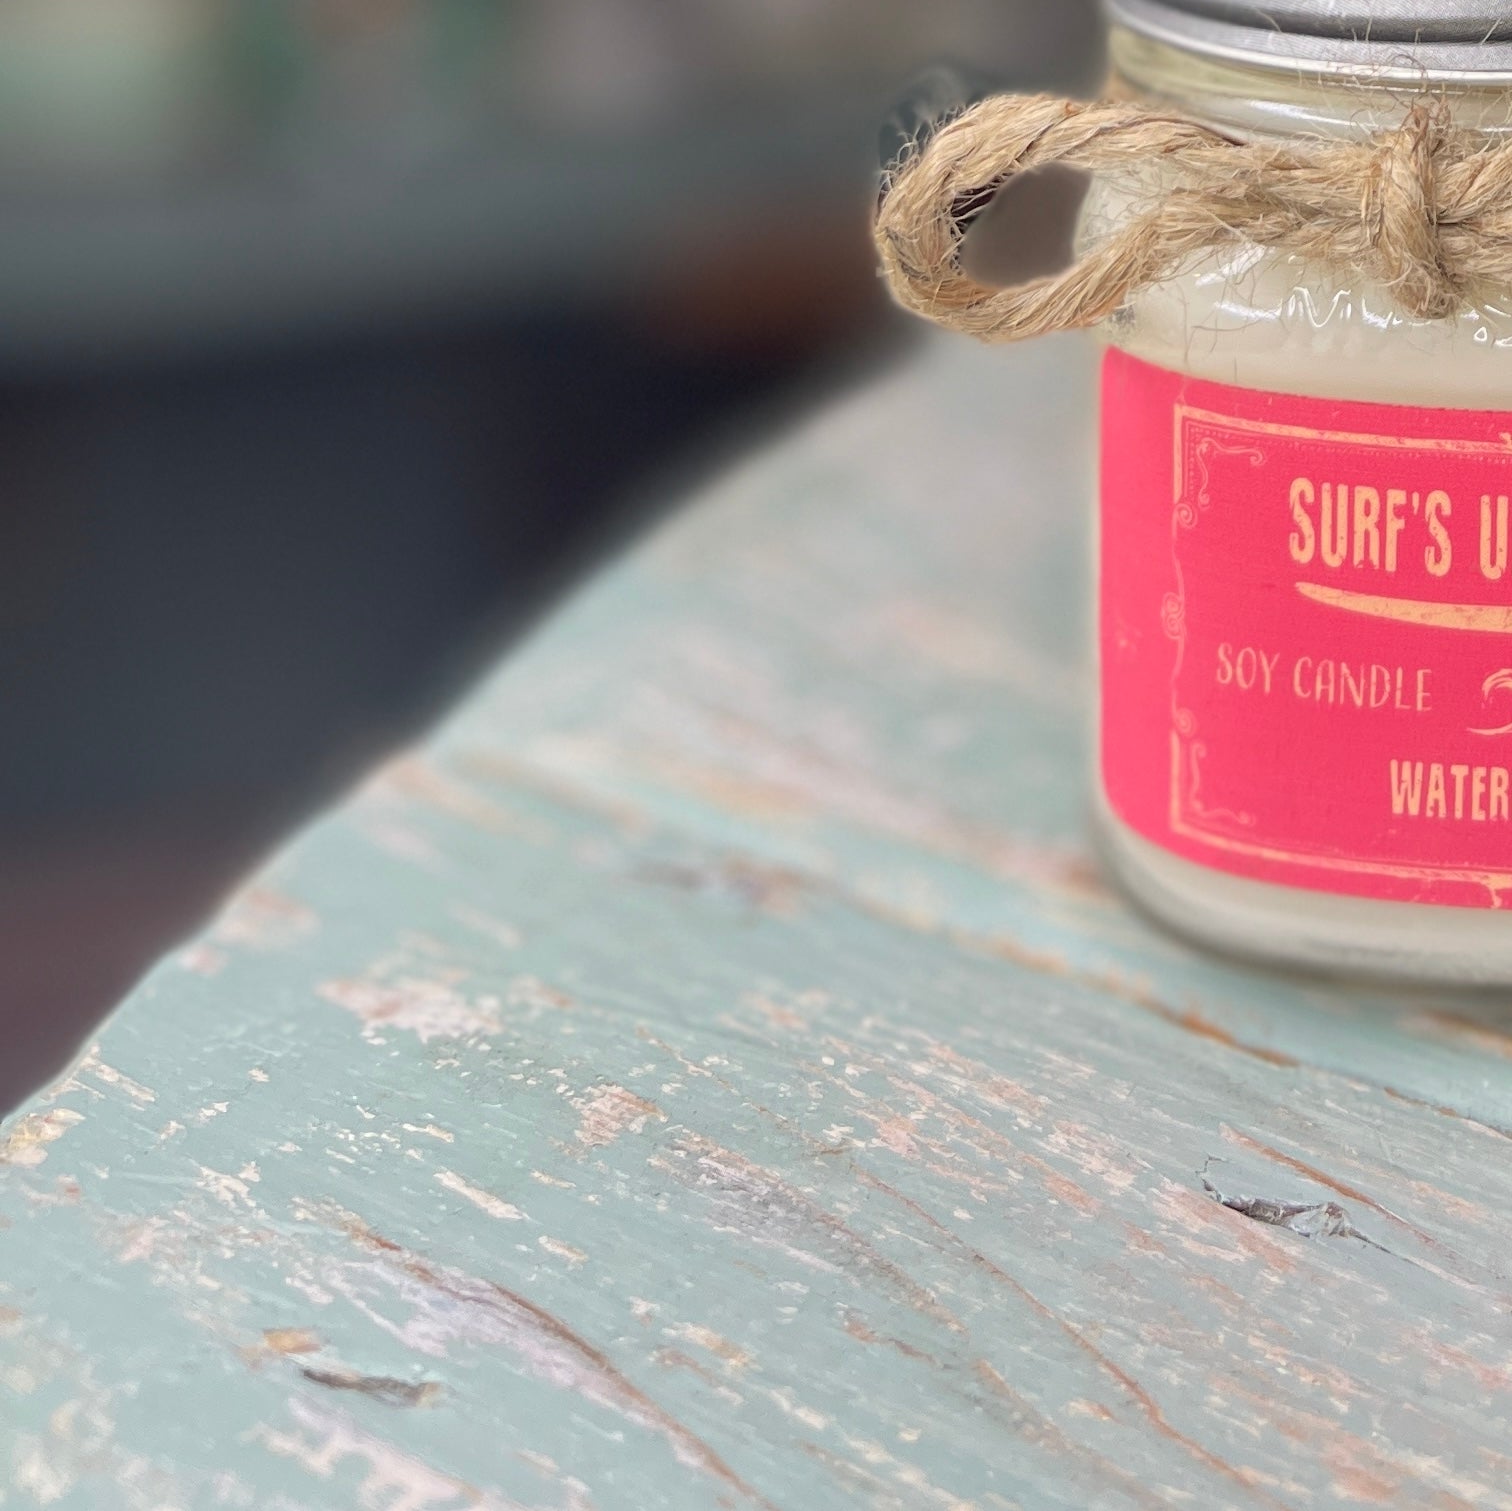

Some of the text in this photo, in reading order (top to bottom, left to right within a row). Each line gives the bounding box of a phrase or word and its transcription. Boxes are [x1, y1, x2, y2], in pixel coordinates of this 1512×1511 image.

[1288, 476, 1453, 578] SURF'S
[1216, 642, 1433, 712] SOY CANDLE
